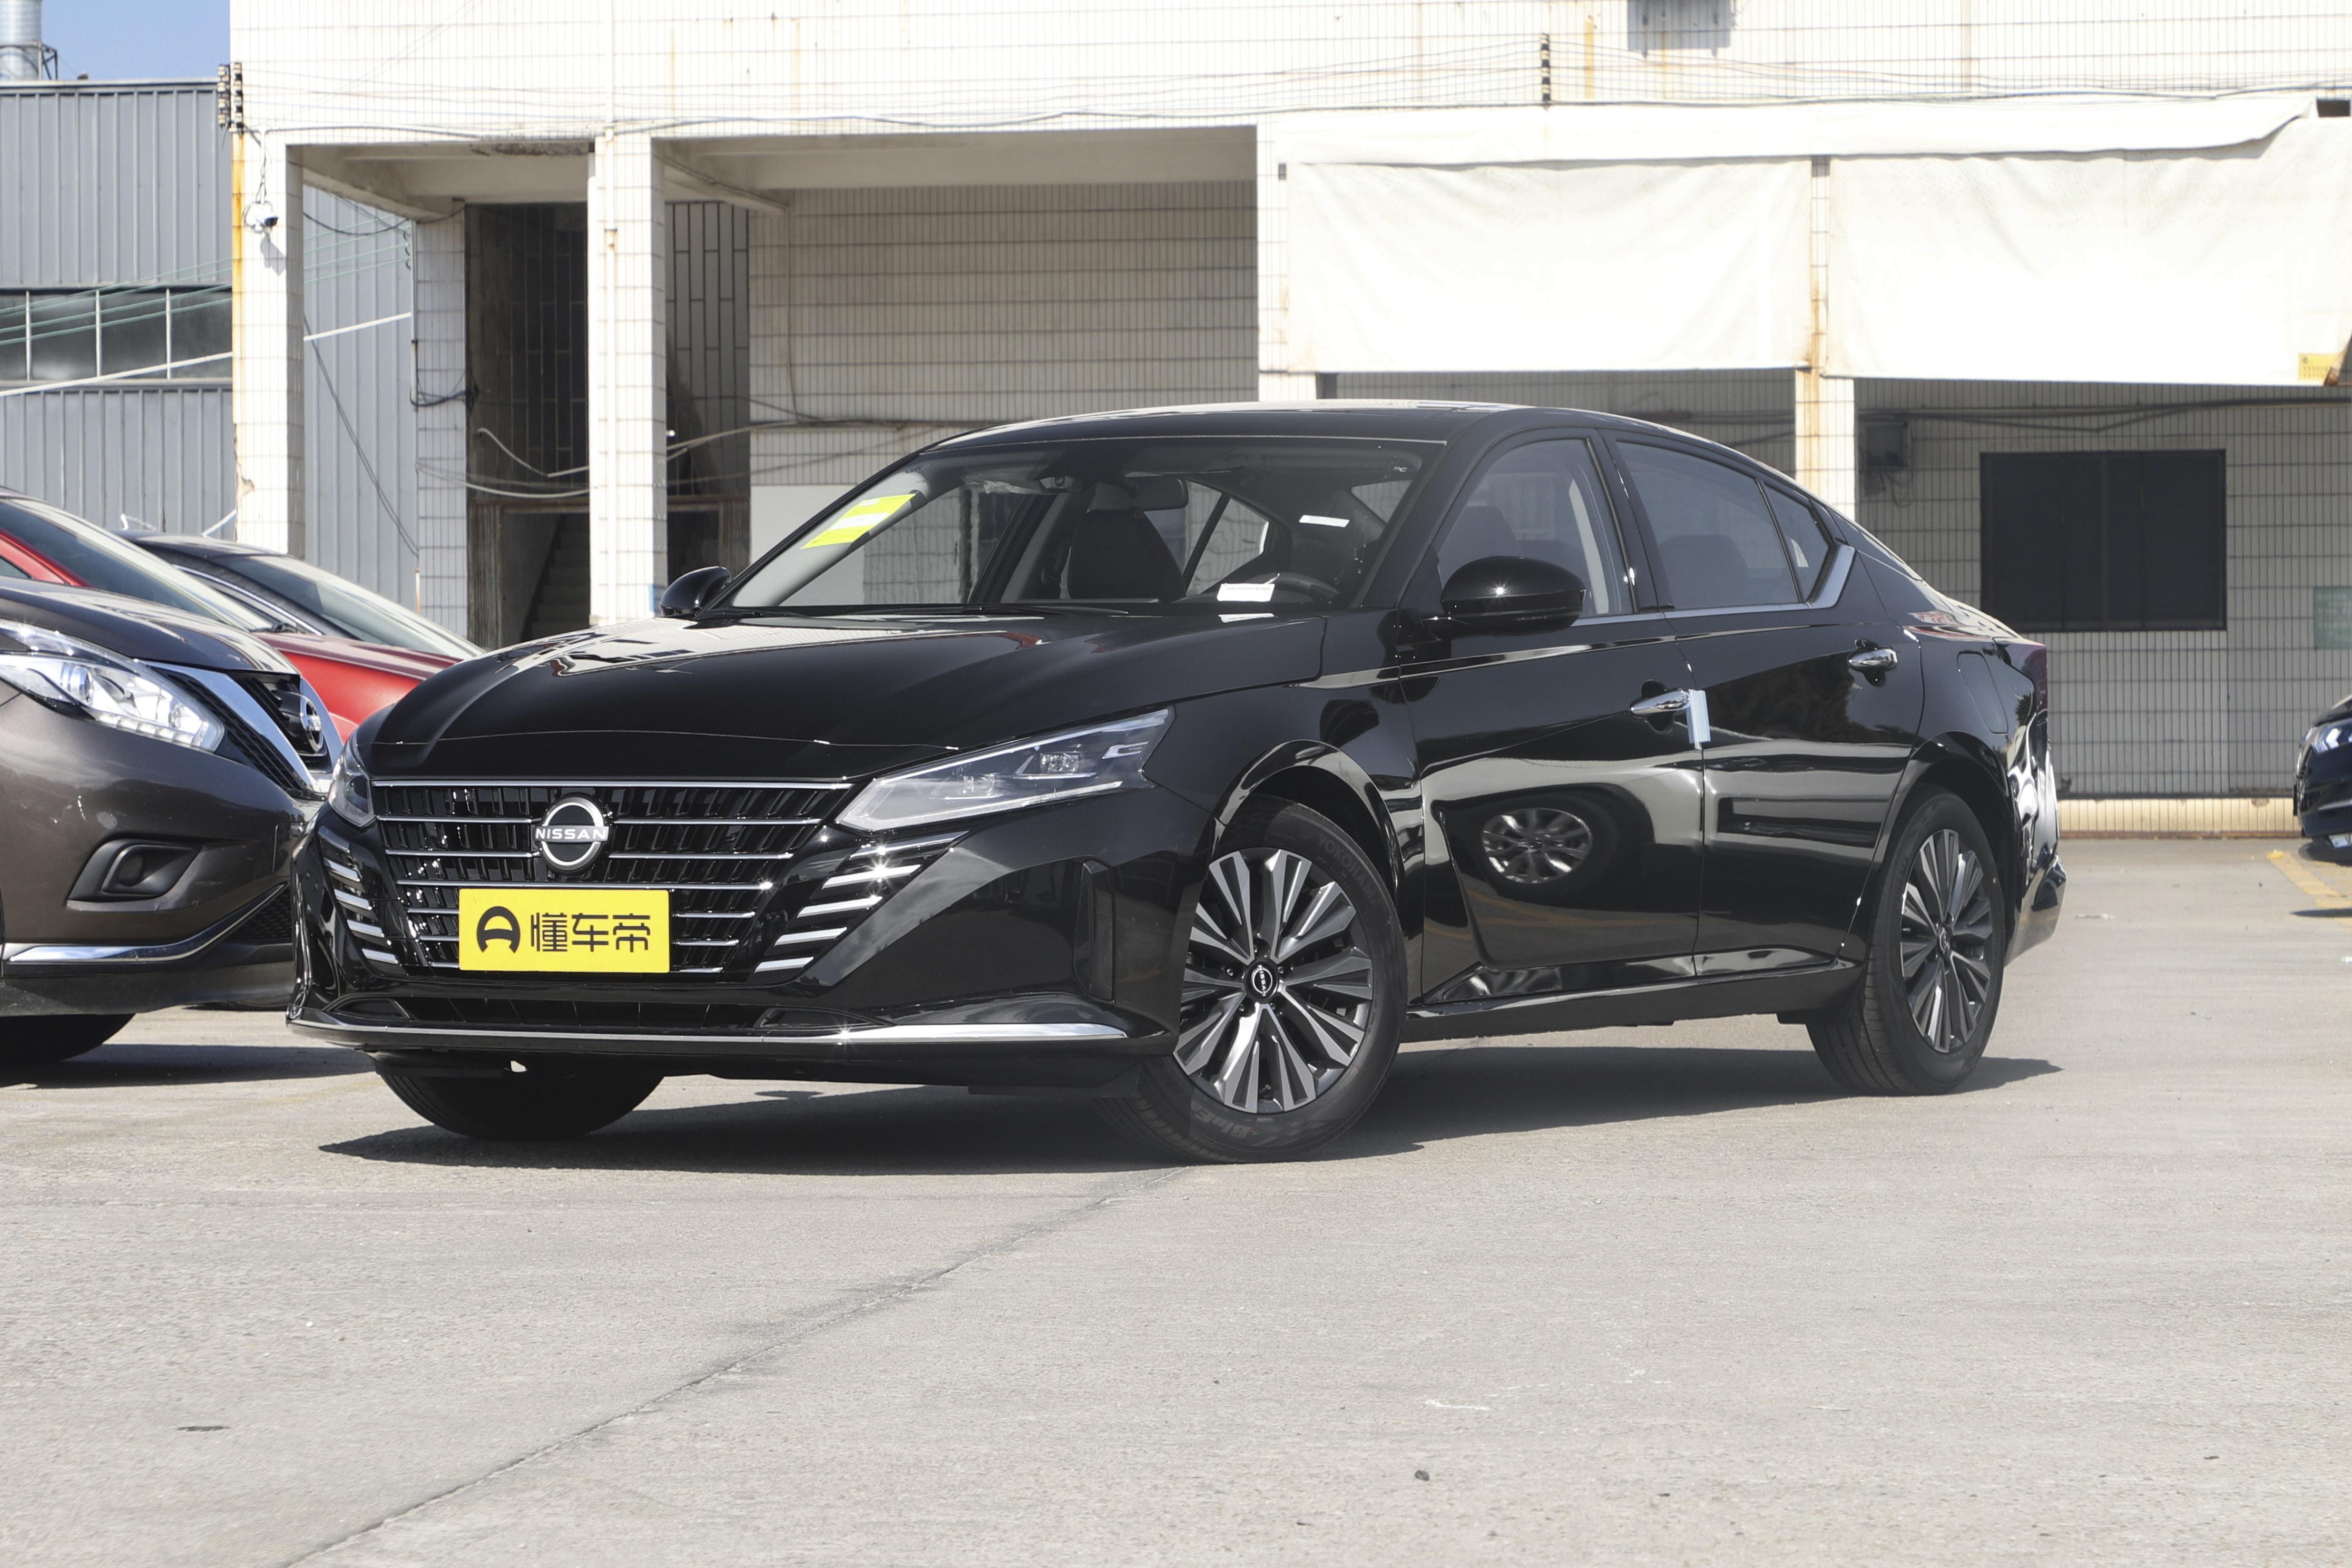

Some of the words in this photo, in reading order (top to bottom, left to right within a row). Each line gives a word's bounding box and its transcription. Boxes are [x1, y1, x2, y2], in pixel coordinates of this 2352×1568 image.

[536, 828, 606, 839] NISSAN
[530, 912, 651, 953] 懂车帝
